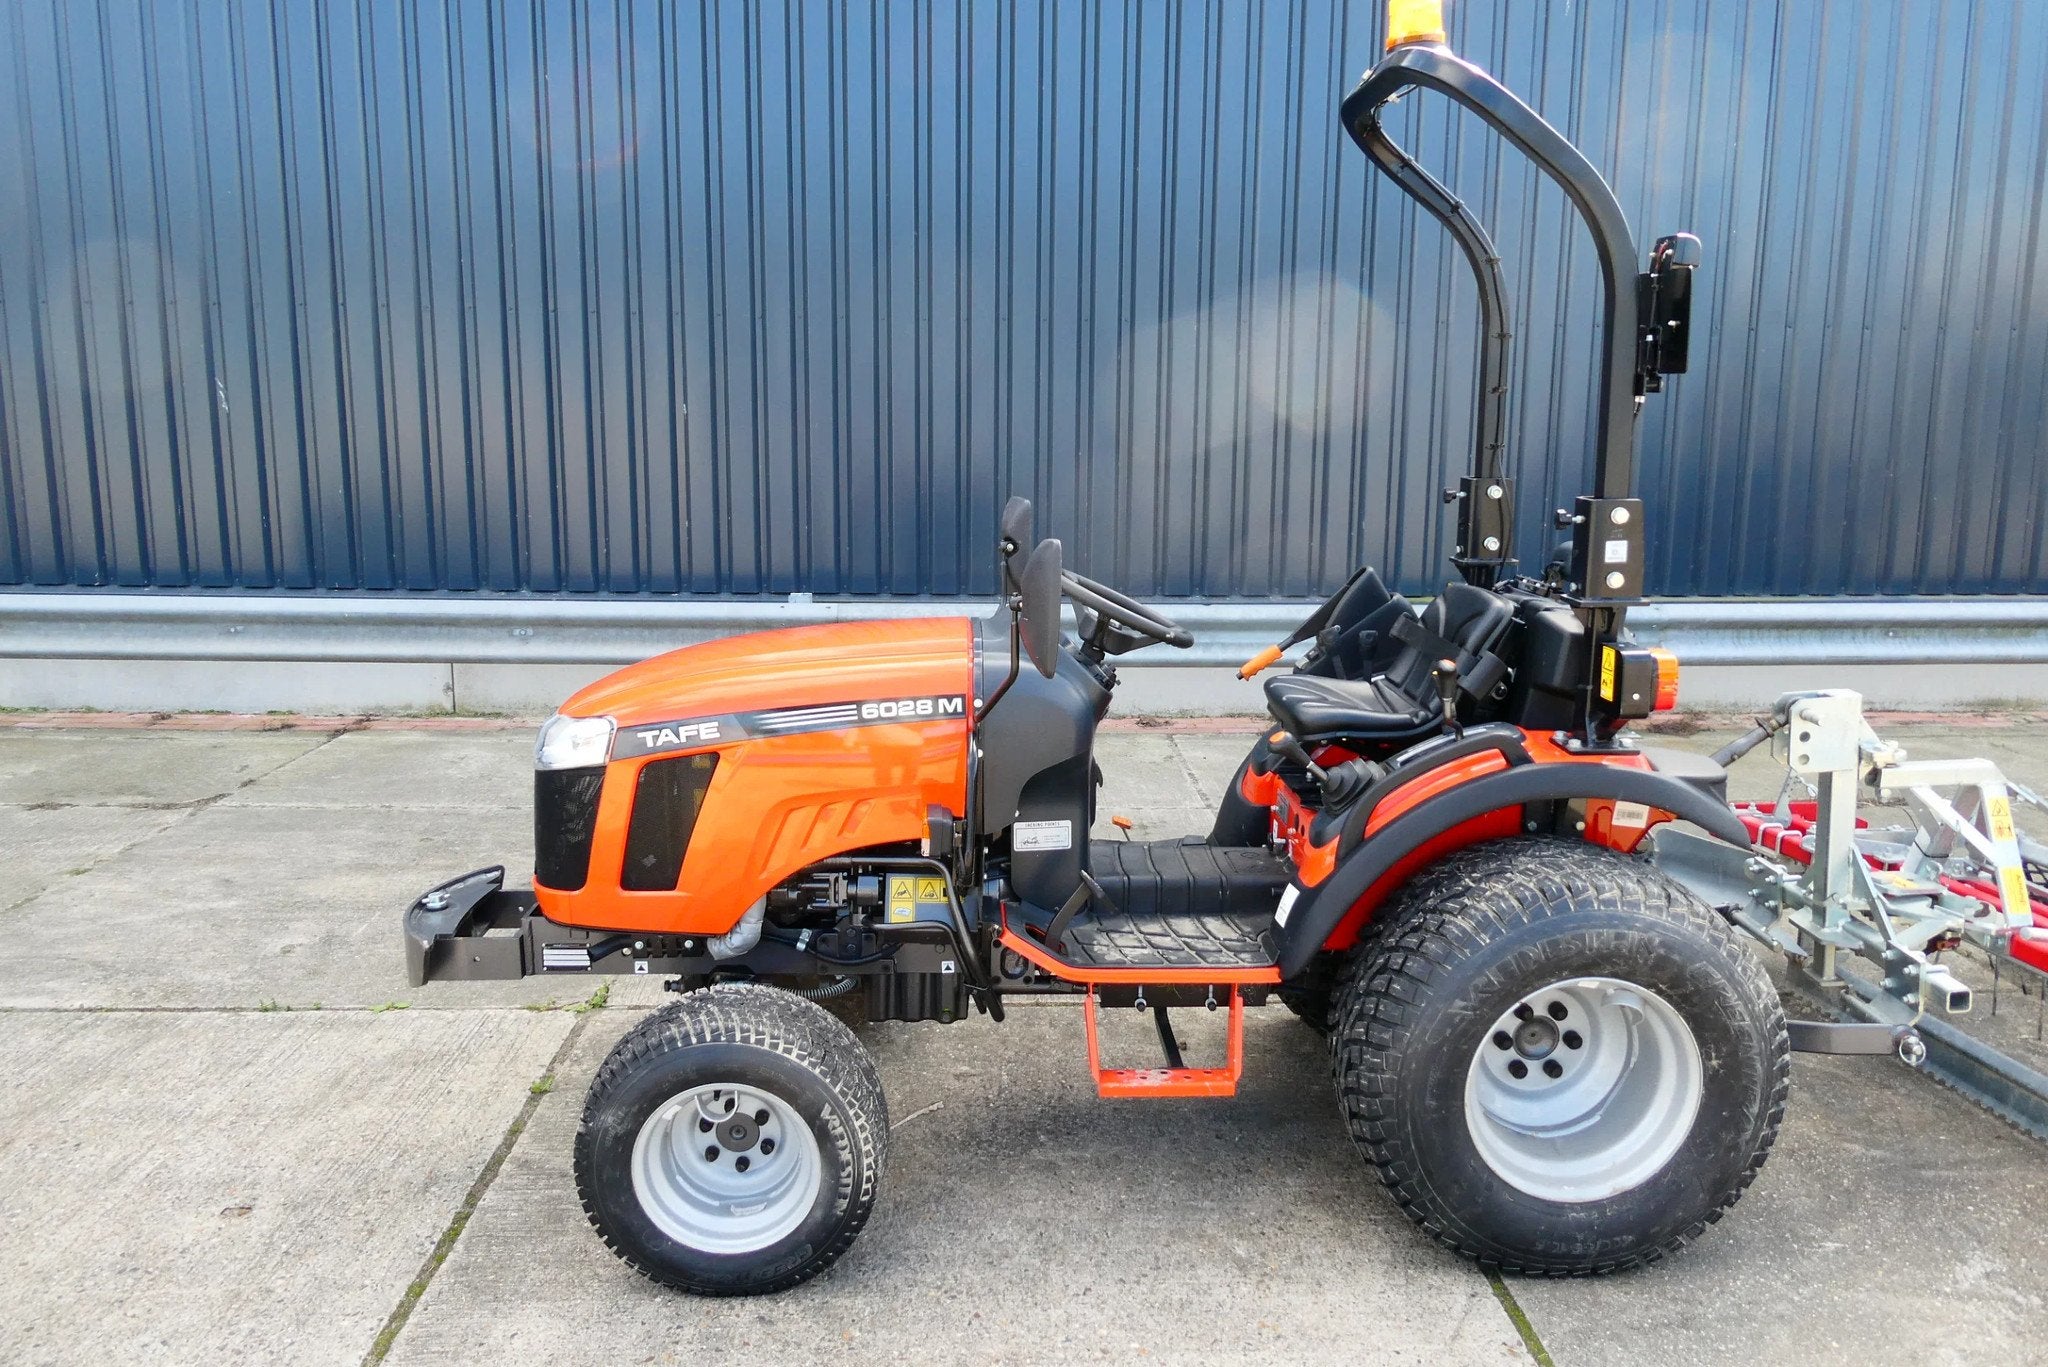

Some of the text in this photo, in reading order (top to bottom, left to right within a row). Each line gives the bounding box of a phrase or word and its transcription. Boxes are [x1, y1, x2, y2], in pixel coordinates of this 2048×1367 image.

[861, 698, 963, 720] 6028 M
[637, 721, 721, 749] TAFE
